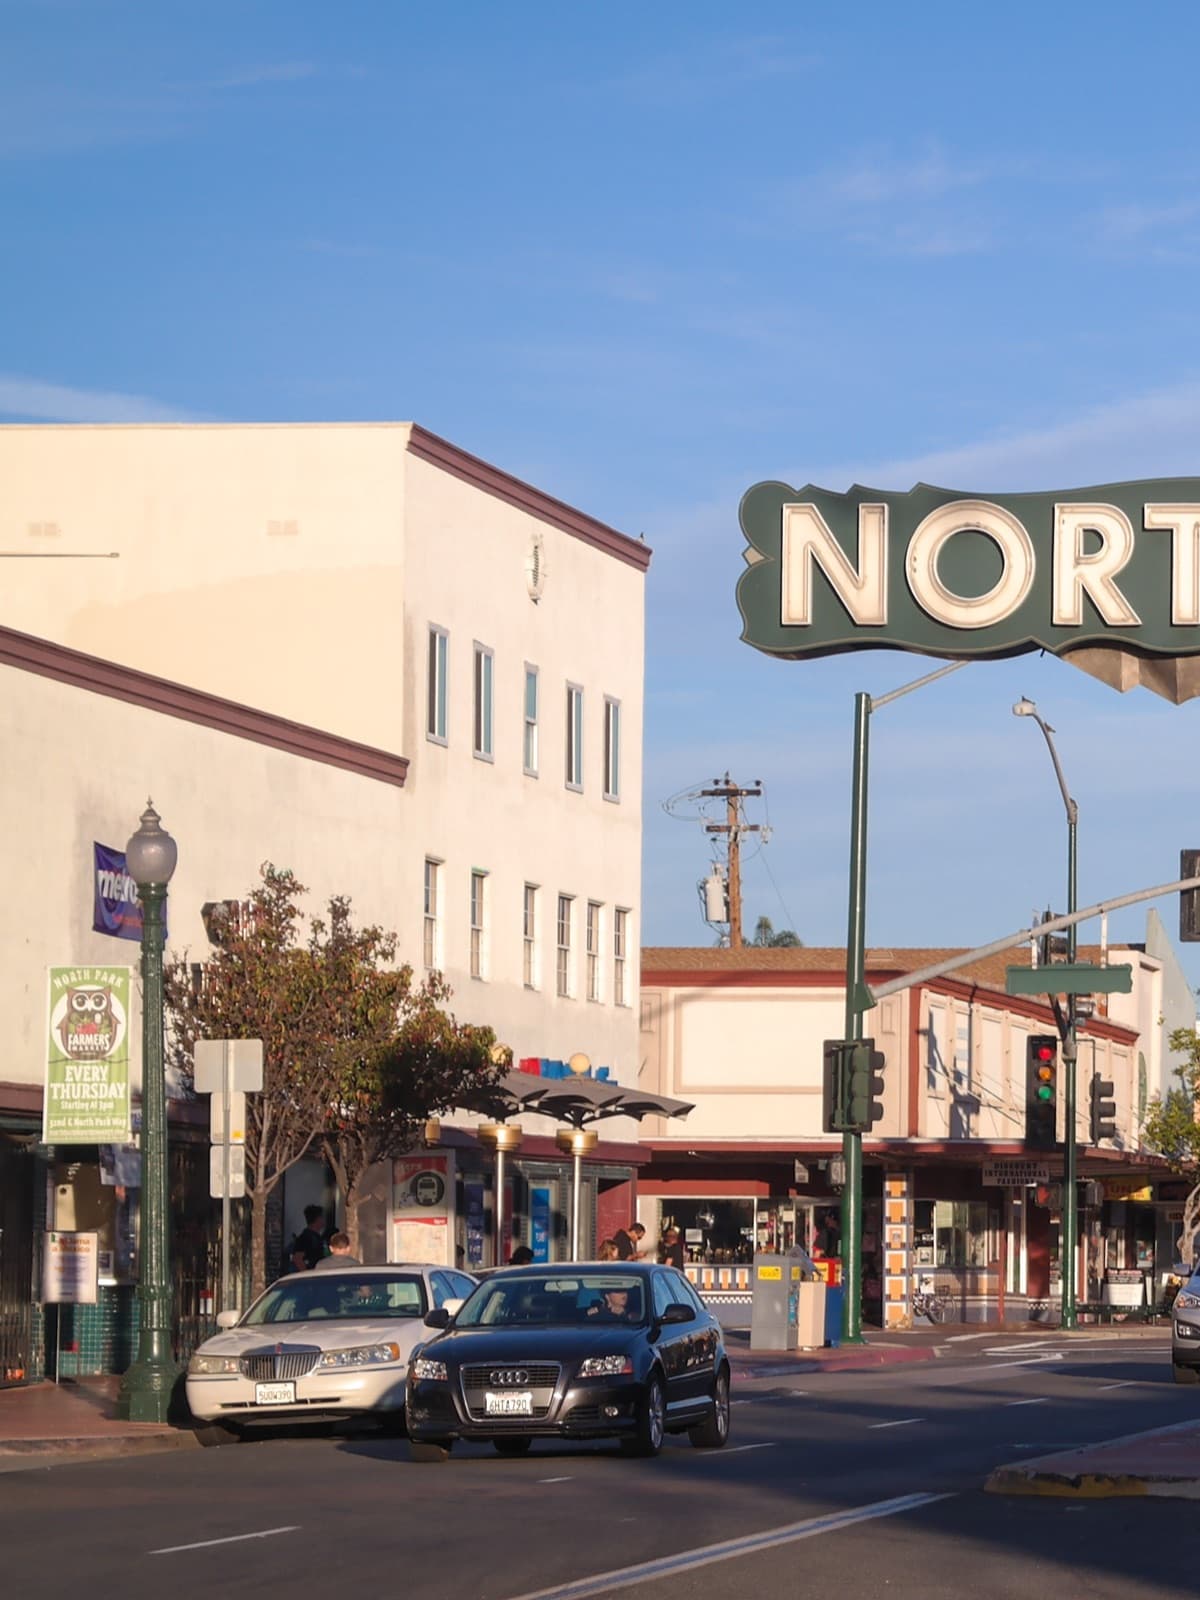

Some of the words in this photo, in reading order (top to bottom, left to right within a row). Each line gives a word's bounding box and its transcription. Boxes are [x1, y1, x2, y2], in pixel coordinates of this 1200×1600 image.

[53, 969, 90, 989] NORTH
[95, 969, 124, 988] PARK
[64, 1065, 109, 1082] EVERY
[50, 1082, 127, 1099] THURSDAY
[61, 1101, 89, 1112] Starting
[73, 1117, 94, 1127] North
[984, 1169, 1047, 1177] INTERNATIONAL
